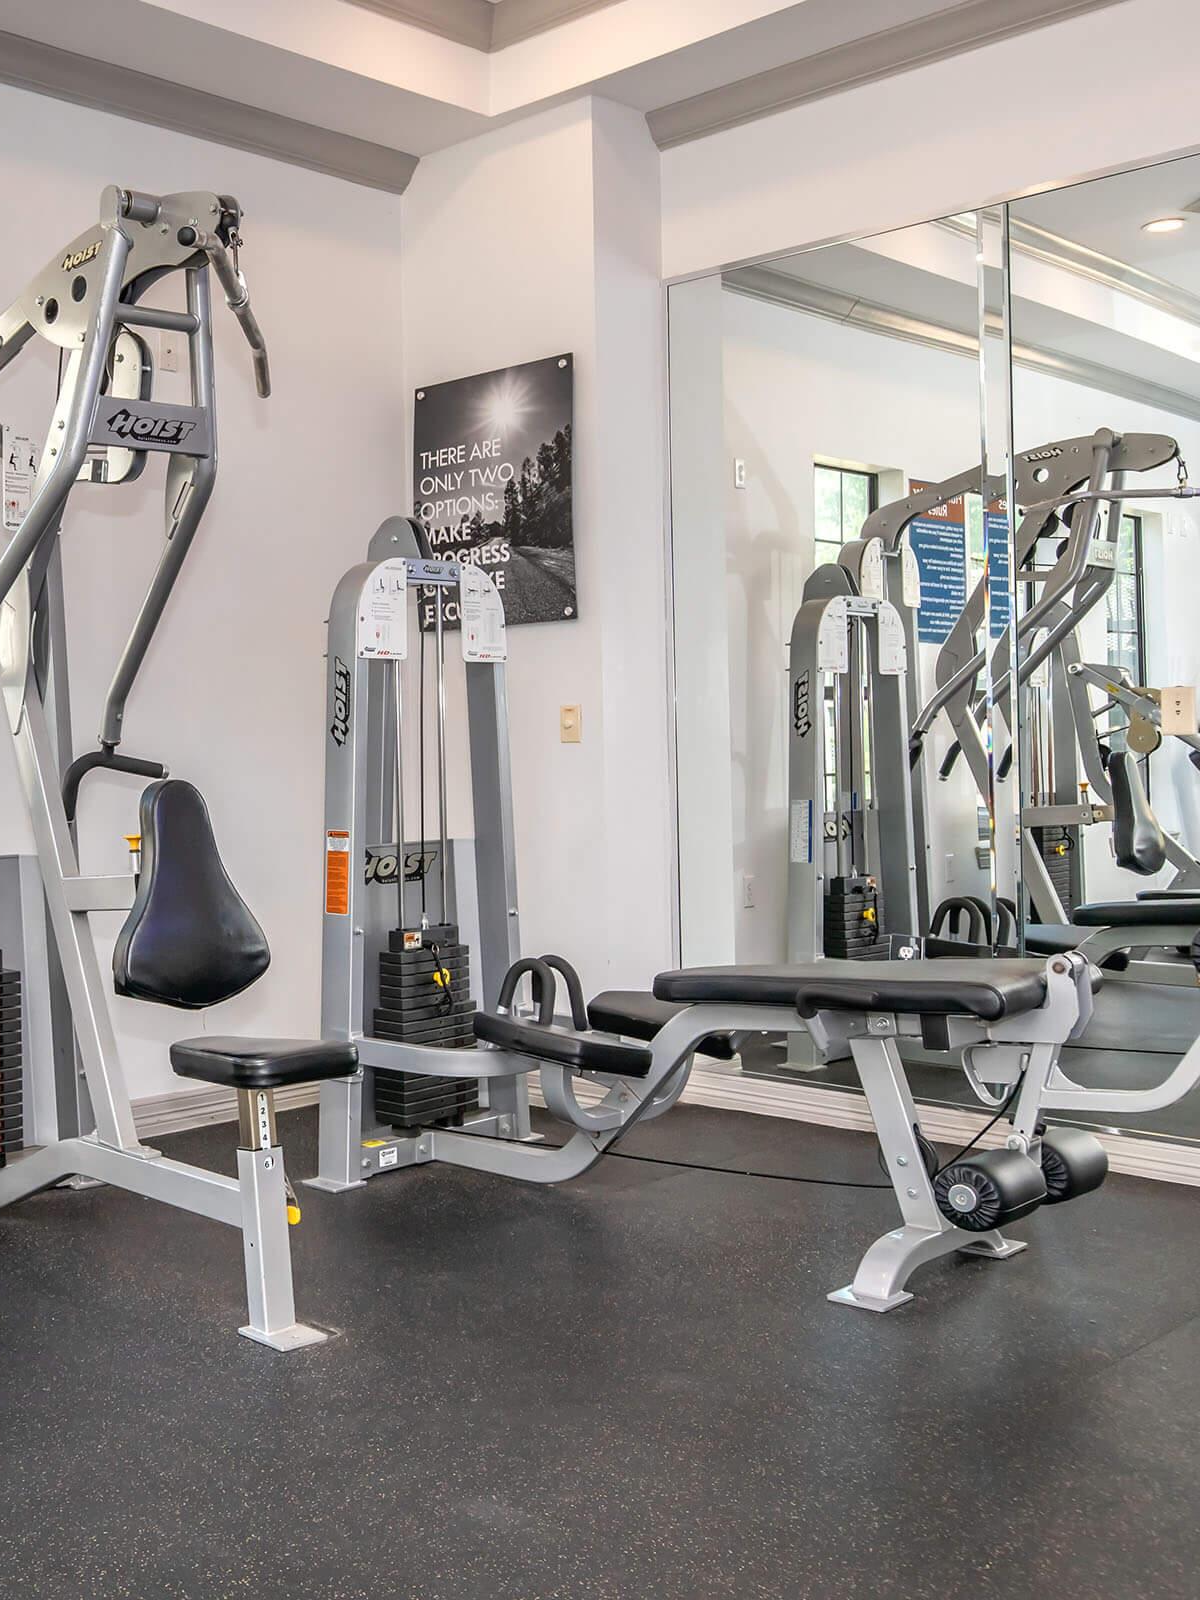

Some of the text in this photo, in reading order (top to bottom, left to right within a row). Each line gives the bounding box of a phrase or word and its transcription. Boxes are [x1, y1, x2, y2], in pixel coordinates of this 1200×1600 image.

[62, 240, 102, 272] HOIST
[108, 410, 196, 440] HOIST
[420, 438, 501, 470] THERE ARE
[420, 462, 514, 495] ONLY TWO
[421, 492, 498, 520] OPTIONS:
[331, 656, 351, 746] HOIST
